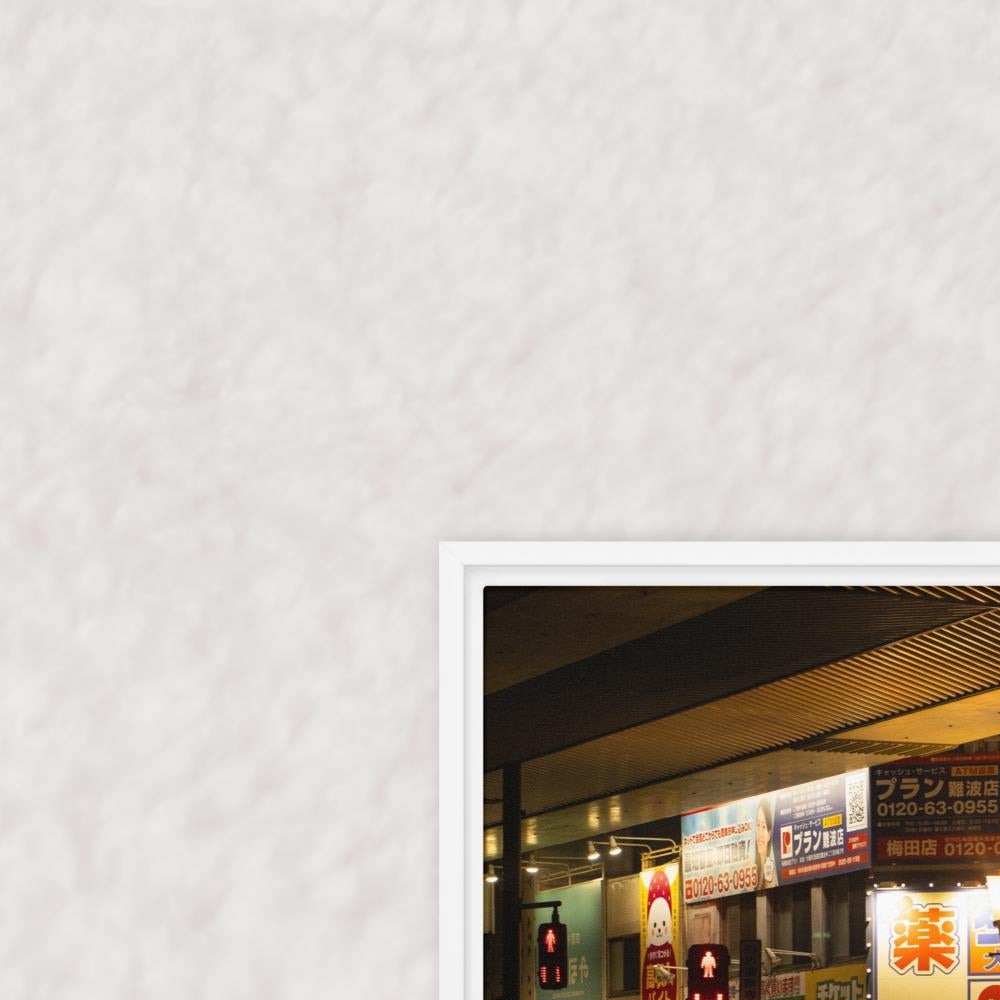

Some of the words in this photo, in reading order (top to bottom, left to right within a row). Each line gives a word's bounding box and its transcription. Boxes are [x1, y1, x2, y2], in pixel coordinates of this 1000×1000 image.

[876, 777, 944, 800] プラン
[948, 780, 999, 798] 難波店
[877, 799, 999, 817] 0120-63-0955
[793, 829, 821, 856] プラン
[886, 839, 938, 857] 梅田店
[693, 865, 758, 898] 0120-63-0955
[890, 905, 958, 973] 薬
